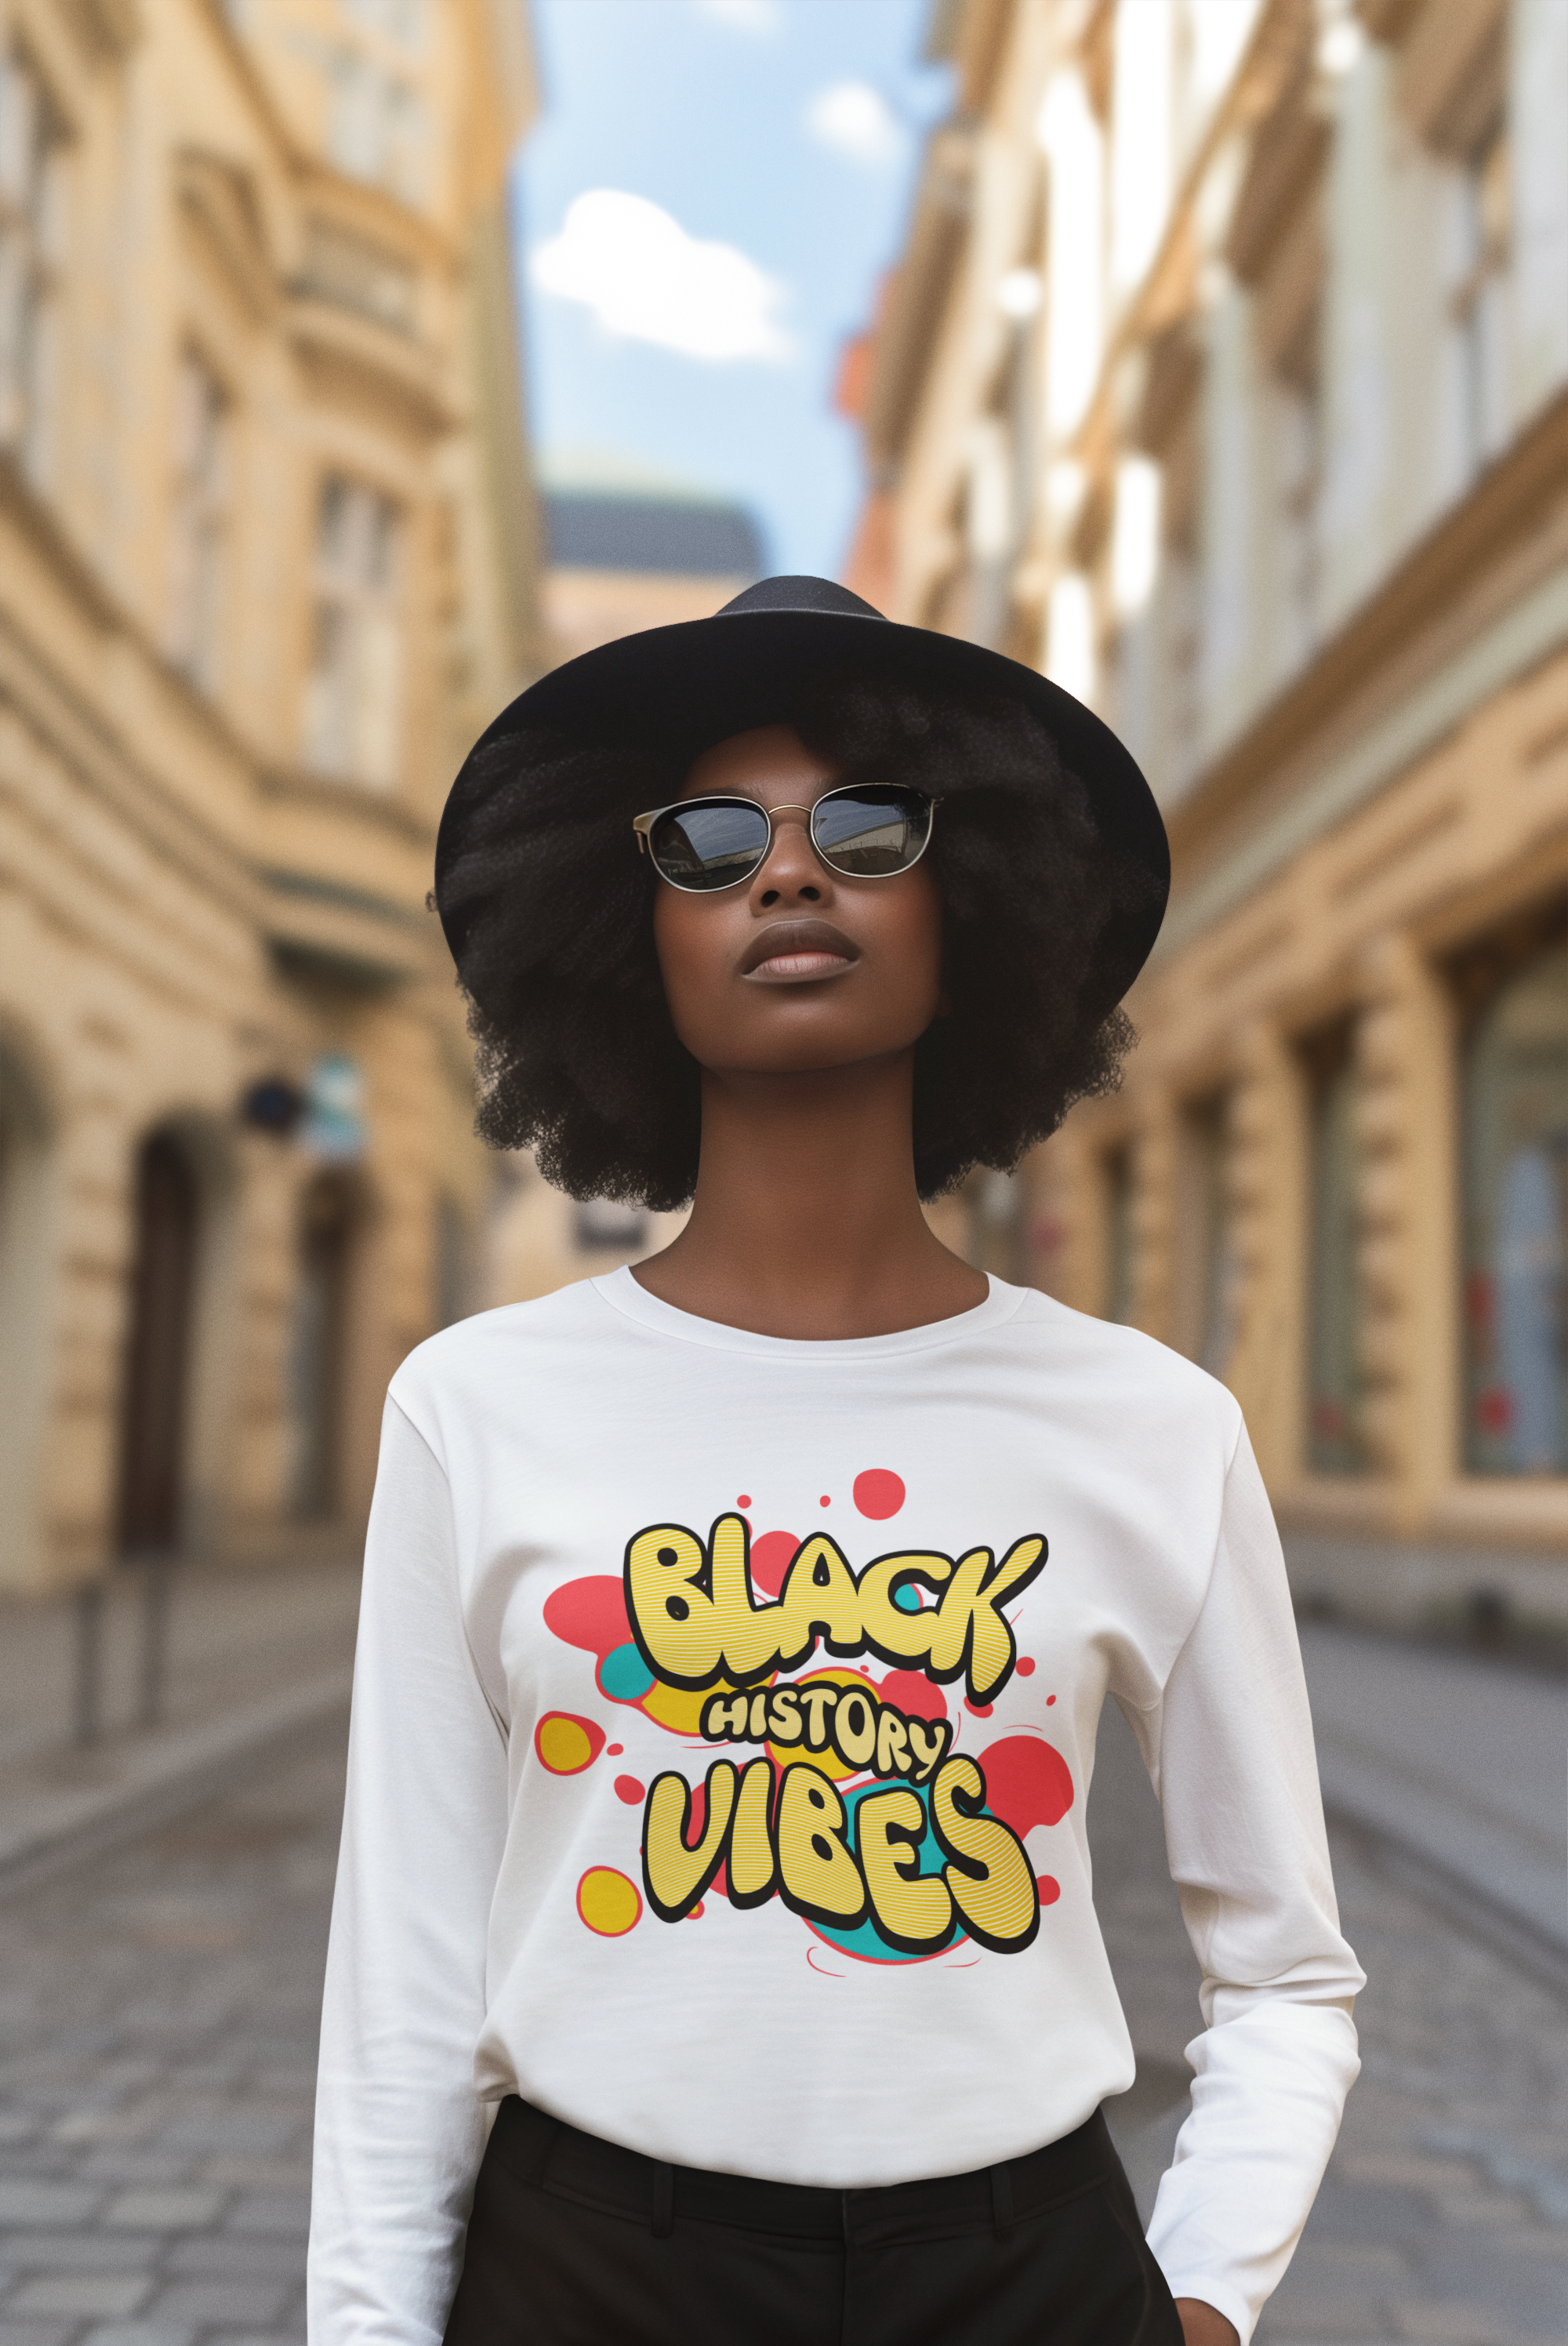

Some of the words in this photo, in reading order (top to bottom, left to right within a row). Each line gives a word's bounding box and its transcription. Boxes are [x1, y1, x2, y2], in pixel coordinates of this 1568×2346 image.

[624, 1512, 1048, 1707] BLACK
[699, 1680, 953, 1788] HISTORY
[642, 1753, 1040, 1954] VIBES
